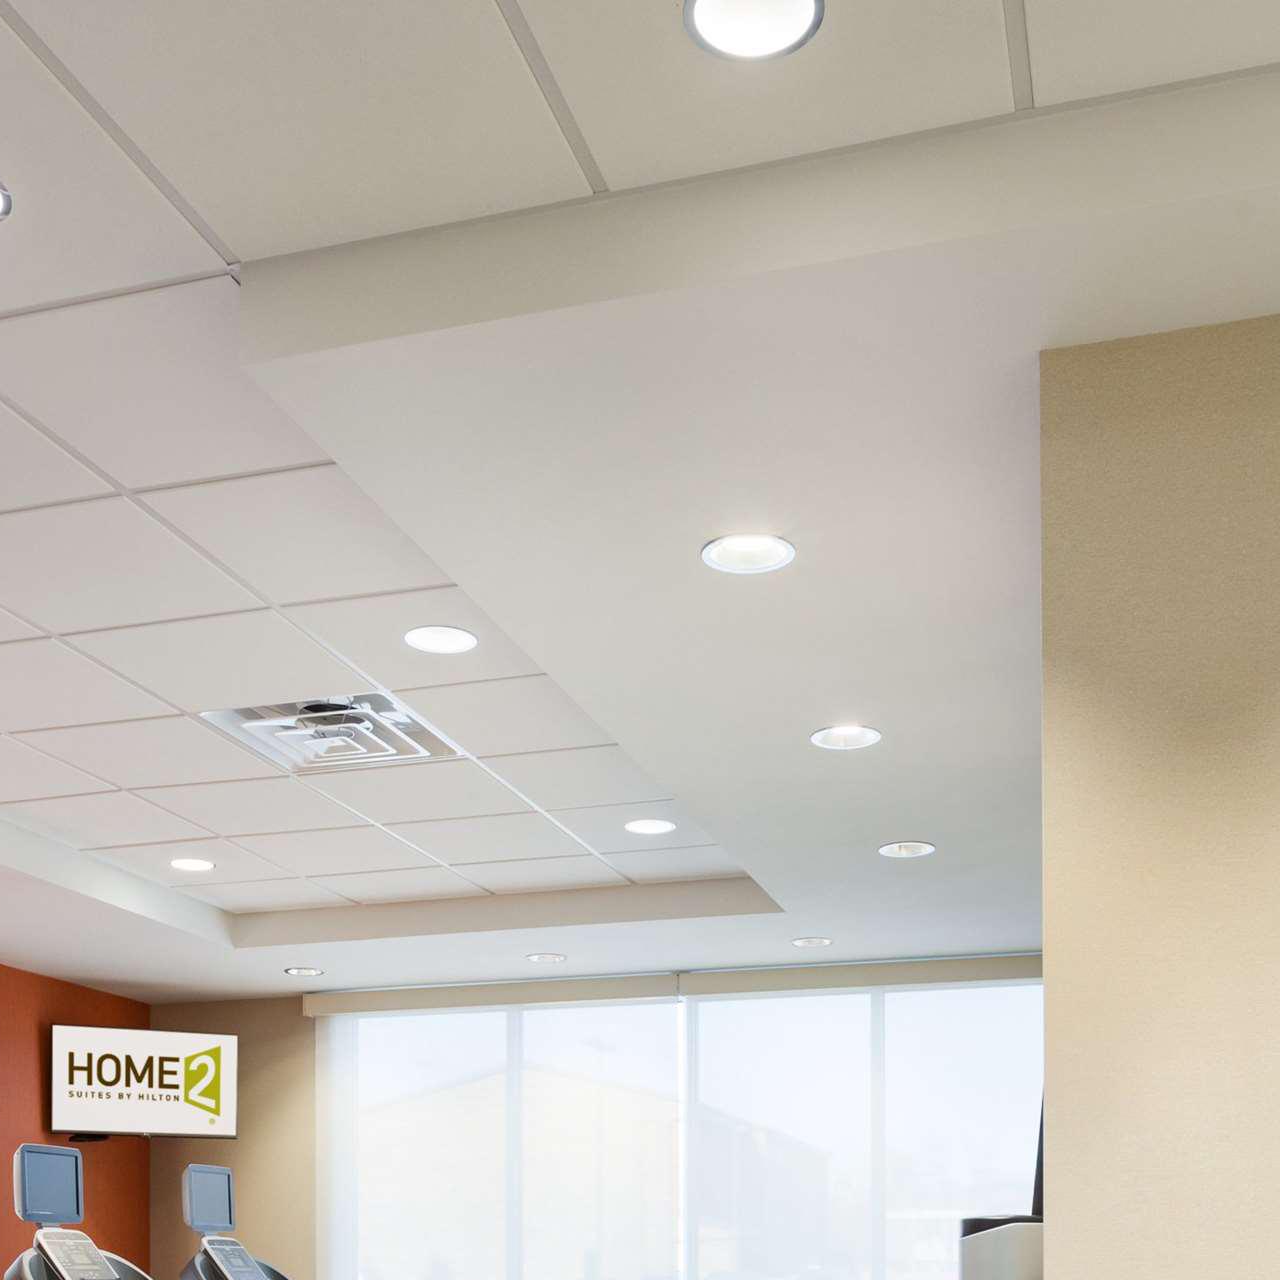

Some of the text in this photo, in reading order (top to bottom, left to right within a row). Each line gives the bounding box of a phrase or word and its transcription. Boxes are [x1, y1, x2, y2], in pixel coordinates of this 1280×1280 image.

[68, 1051, 180, 1090] HOME
[68, 1090, 180, 1103] SUITES BY HILTON
